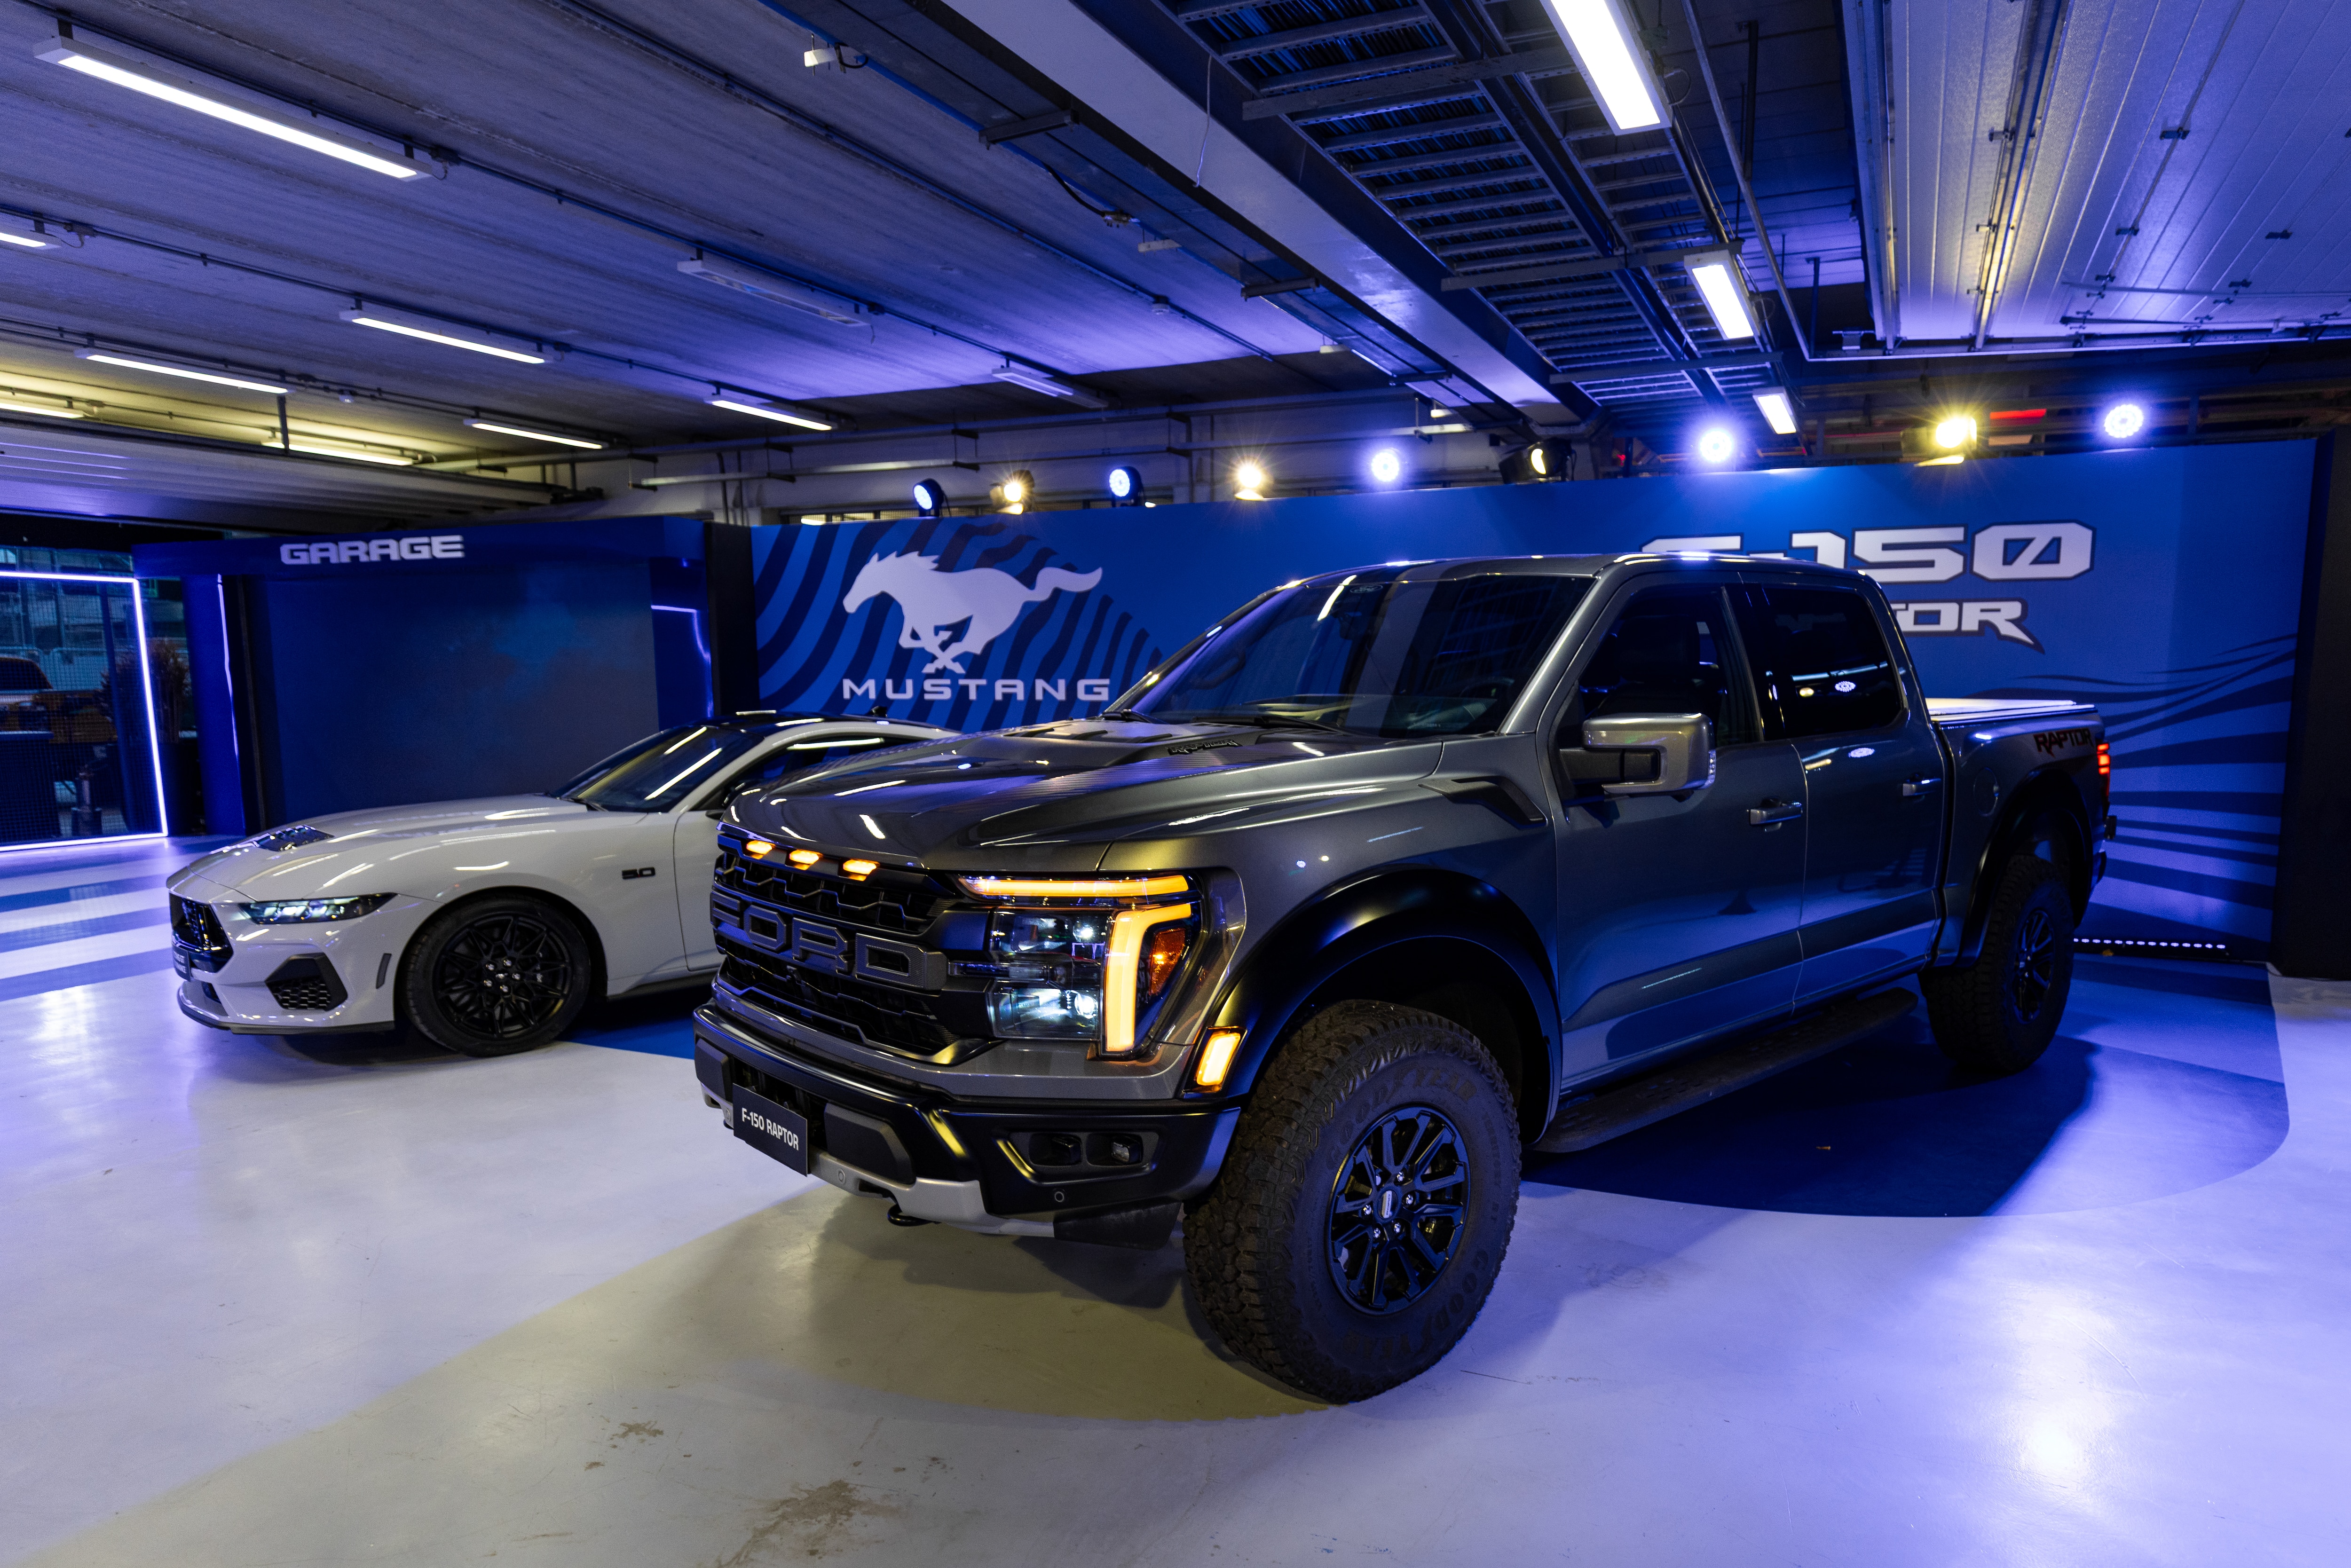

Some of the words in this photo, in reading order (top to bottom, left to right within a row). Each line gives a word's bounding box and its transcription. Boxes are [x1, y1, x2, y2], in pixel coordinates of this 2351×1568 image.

[280, 535, 464, 564] GARAGE
[842, 678, 1110, 701] MUSTANG
[1167, 738, 1243, 755] RAPTOR
[2033, 727, 2094, 758] RAPTOR
[621, 867, 655, 880] 5.0
[710, 892, 929, 988] FORD
[742, 1107, 765, 1130] F-150
[766, 1119, 799, 1151] RAPTOR
[1326, 1063, 1477, 1170] GOODYEAR
[1342, 1249, 1489, 1361] GOODYEAR
